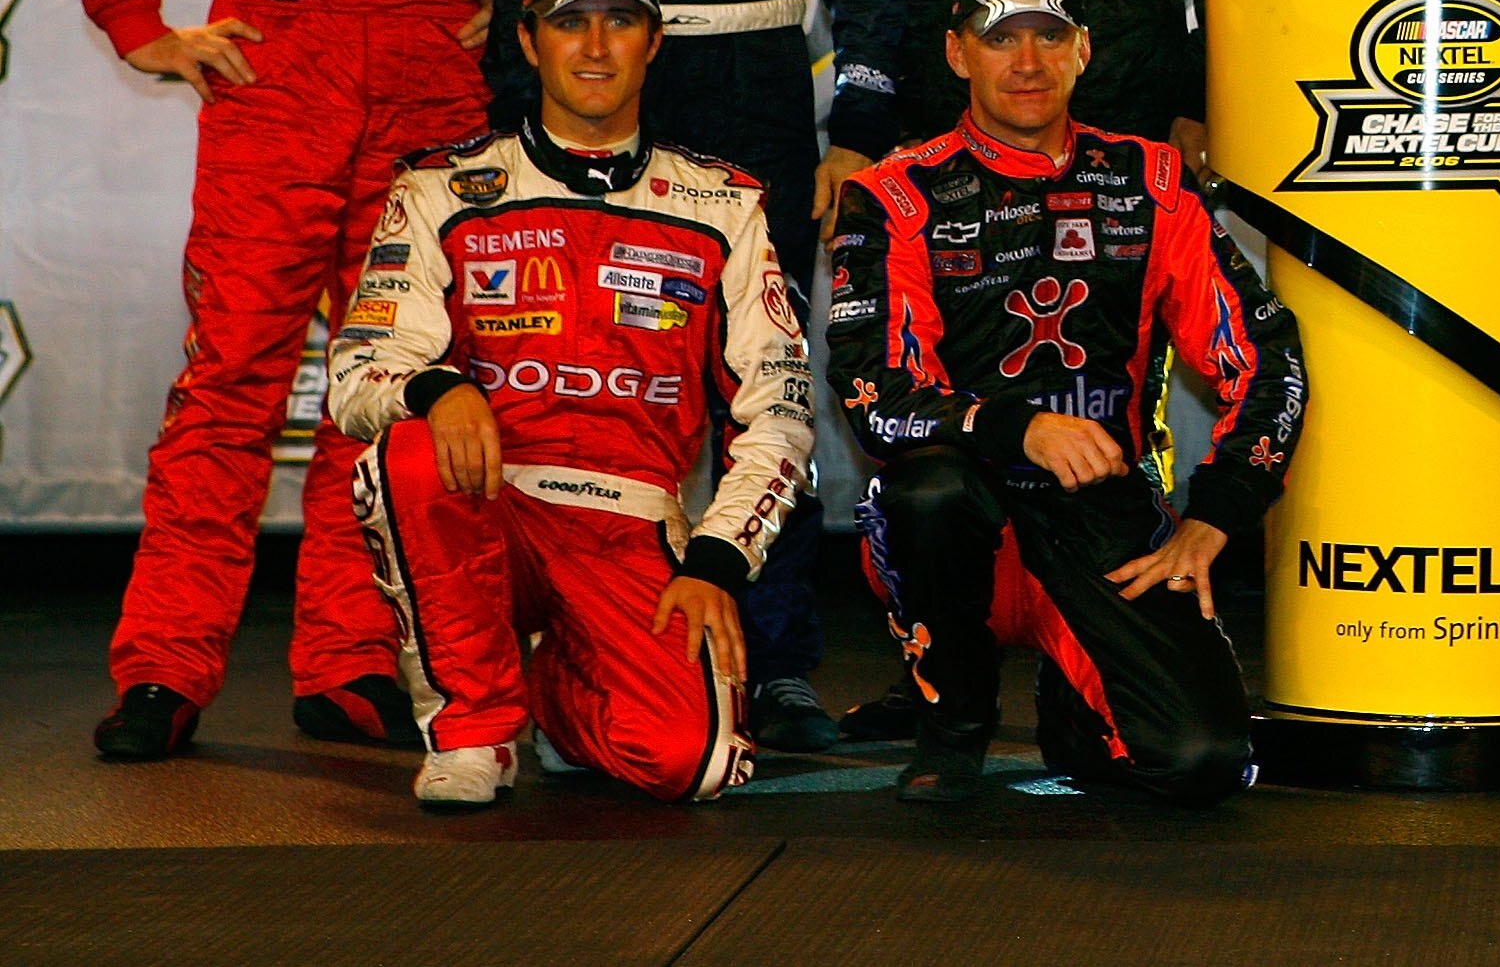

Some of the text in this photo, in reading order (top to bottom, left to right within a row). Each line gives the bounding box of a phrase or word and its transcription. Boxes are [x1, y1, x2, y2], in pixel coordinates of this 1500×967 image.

[1439, 71, 1486, 85] SERIES
[1361, 112, 1470, 135] CHASE
[1344, 133, 1455, 155] NEXTEL
[1399, 155, 1461, 167] 2006
[1076, 170, 1130, 186] cingular
[671, 183, 742, 200] DODGE
[985, 202, 1042, 224] Prilosec
[464, 228, 566, 255] SIEMENS
[352, 301, 390, 314] OSCH
[475, 316, 555, 332] STANLEY
[468, 358, 683, 405] DODGE
[538, 479, 622, 502] GOODYEAR
[1336, 620, 1373, 643] only
[1379, 621, 1426, 640] from
